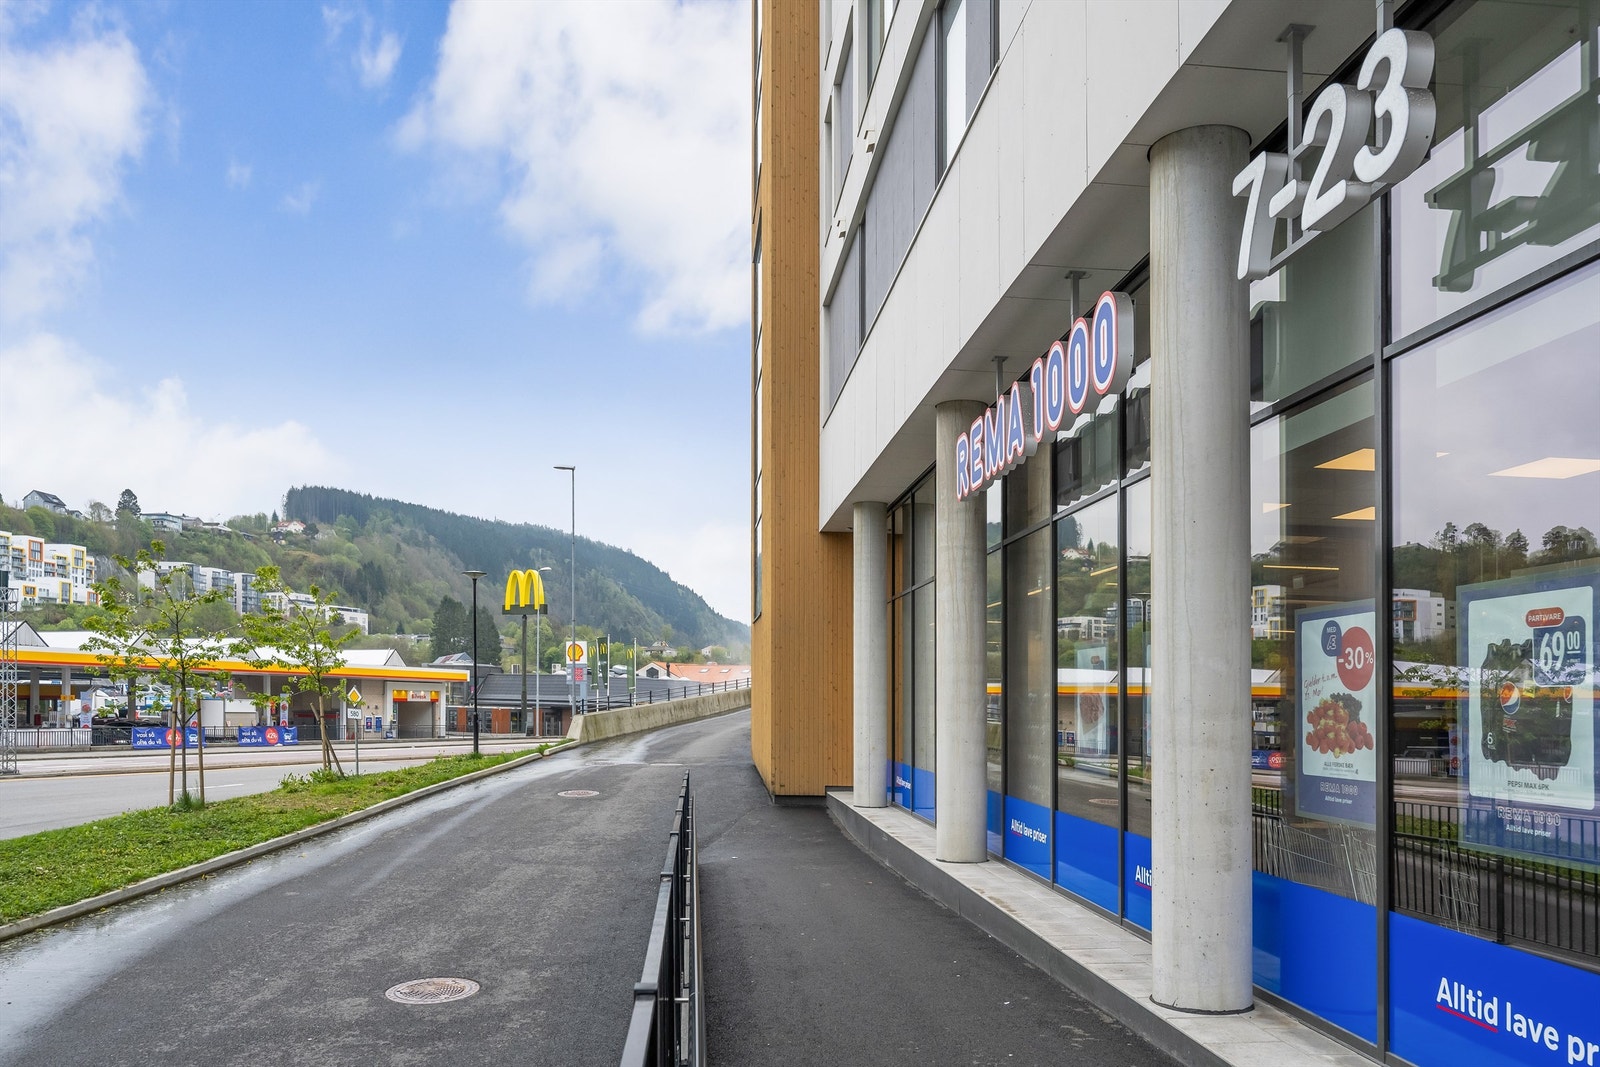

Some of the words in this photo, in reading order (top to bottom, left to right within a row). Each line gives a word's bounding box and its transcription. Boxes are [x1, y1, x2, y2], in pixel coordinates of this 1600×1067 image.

[956, 381, 1025, 502] REMA
[1030, 290, 1119, 443] 1000
[1528, 613, 1562, 622] PARTIVARE
[1338, 646, 1374, 670] -30%
[1540, 631, 1565, 671] 69
[1566, 631, 1580, 650] 00
[1487, 732, 1493, 744] 6
[1320, 782, 1340, 794] REMA
[1341, 784, 1359, 795] 1000
[1507, 780, 1523, 788] PEPSI
[1523, 782, 1537, 790] MAX
[1497, 806, 1531, 823] REMA
[1533, 810, 1561, 826] 1000
[1011, 819, 1022, 834] Alltid
[1023, 822, 1033, 838] lave
[1033, 828, 1047, 844] priser
[1506, 824, 1521, 833] Alltid
[1521, 826, 1533, 835] lave
[1534, 829, 1552, 838] priser
[1135, 865, 1152, 886] Allti
[1436, 977, 1498, 1026] Alltid
[1505, 1001, 1560, 1051] lave
